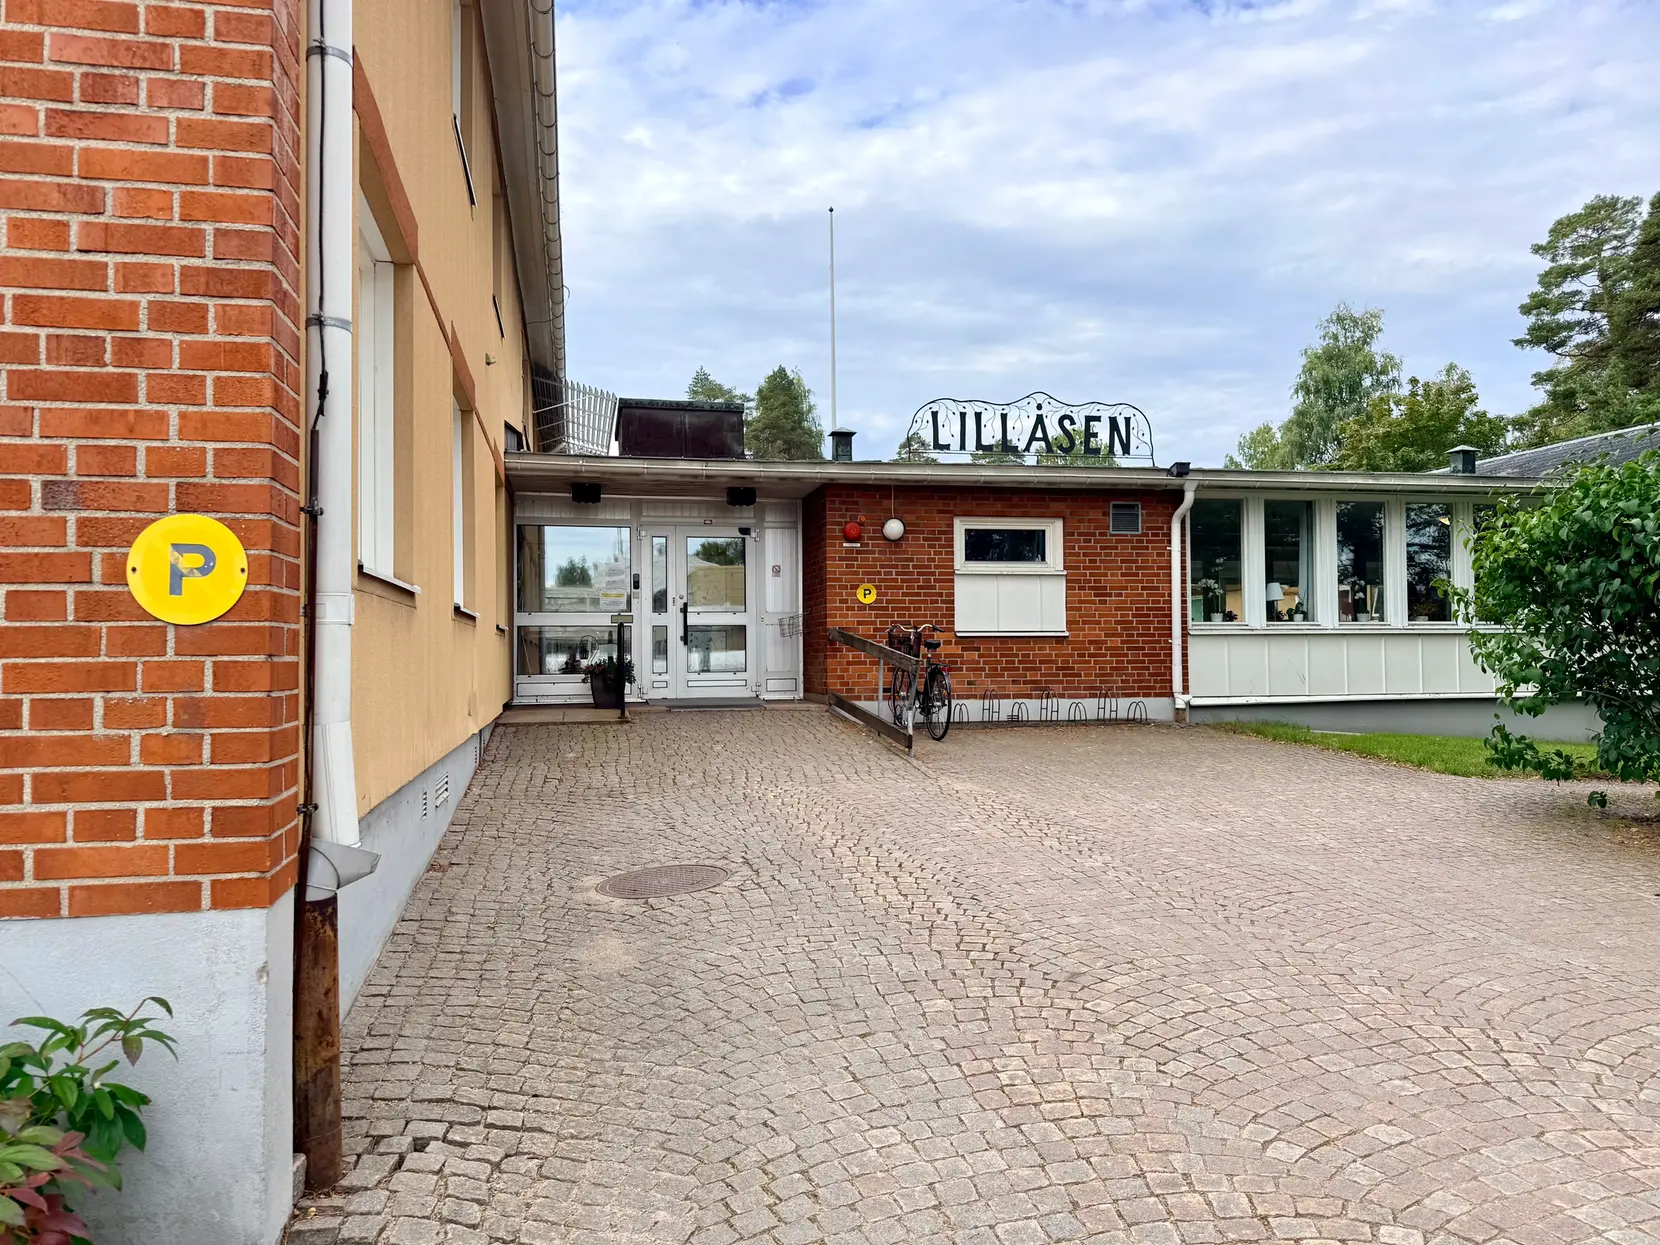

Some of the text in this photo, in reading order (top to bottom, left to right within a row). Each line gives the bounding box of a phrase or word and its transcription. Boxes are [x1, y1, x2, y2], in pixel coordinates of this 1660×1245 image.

[931, 403, 1131, 456] LILLÅSEN
[169, 543, 217, 596] P
[863, 588, 872, 598] P
